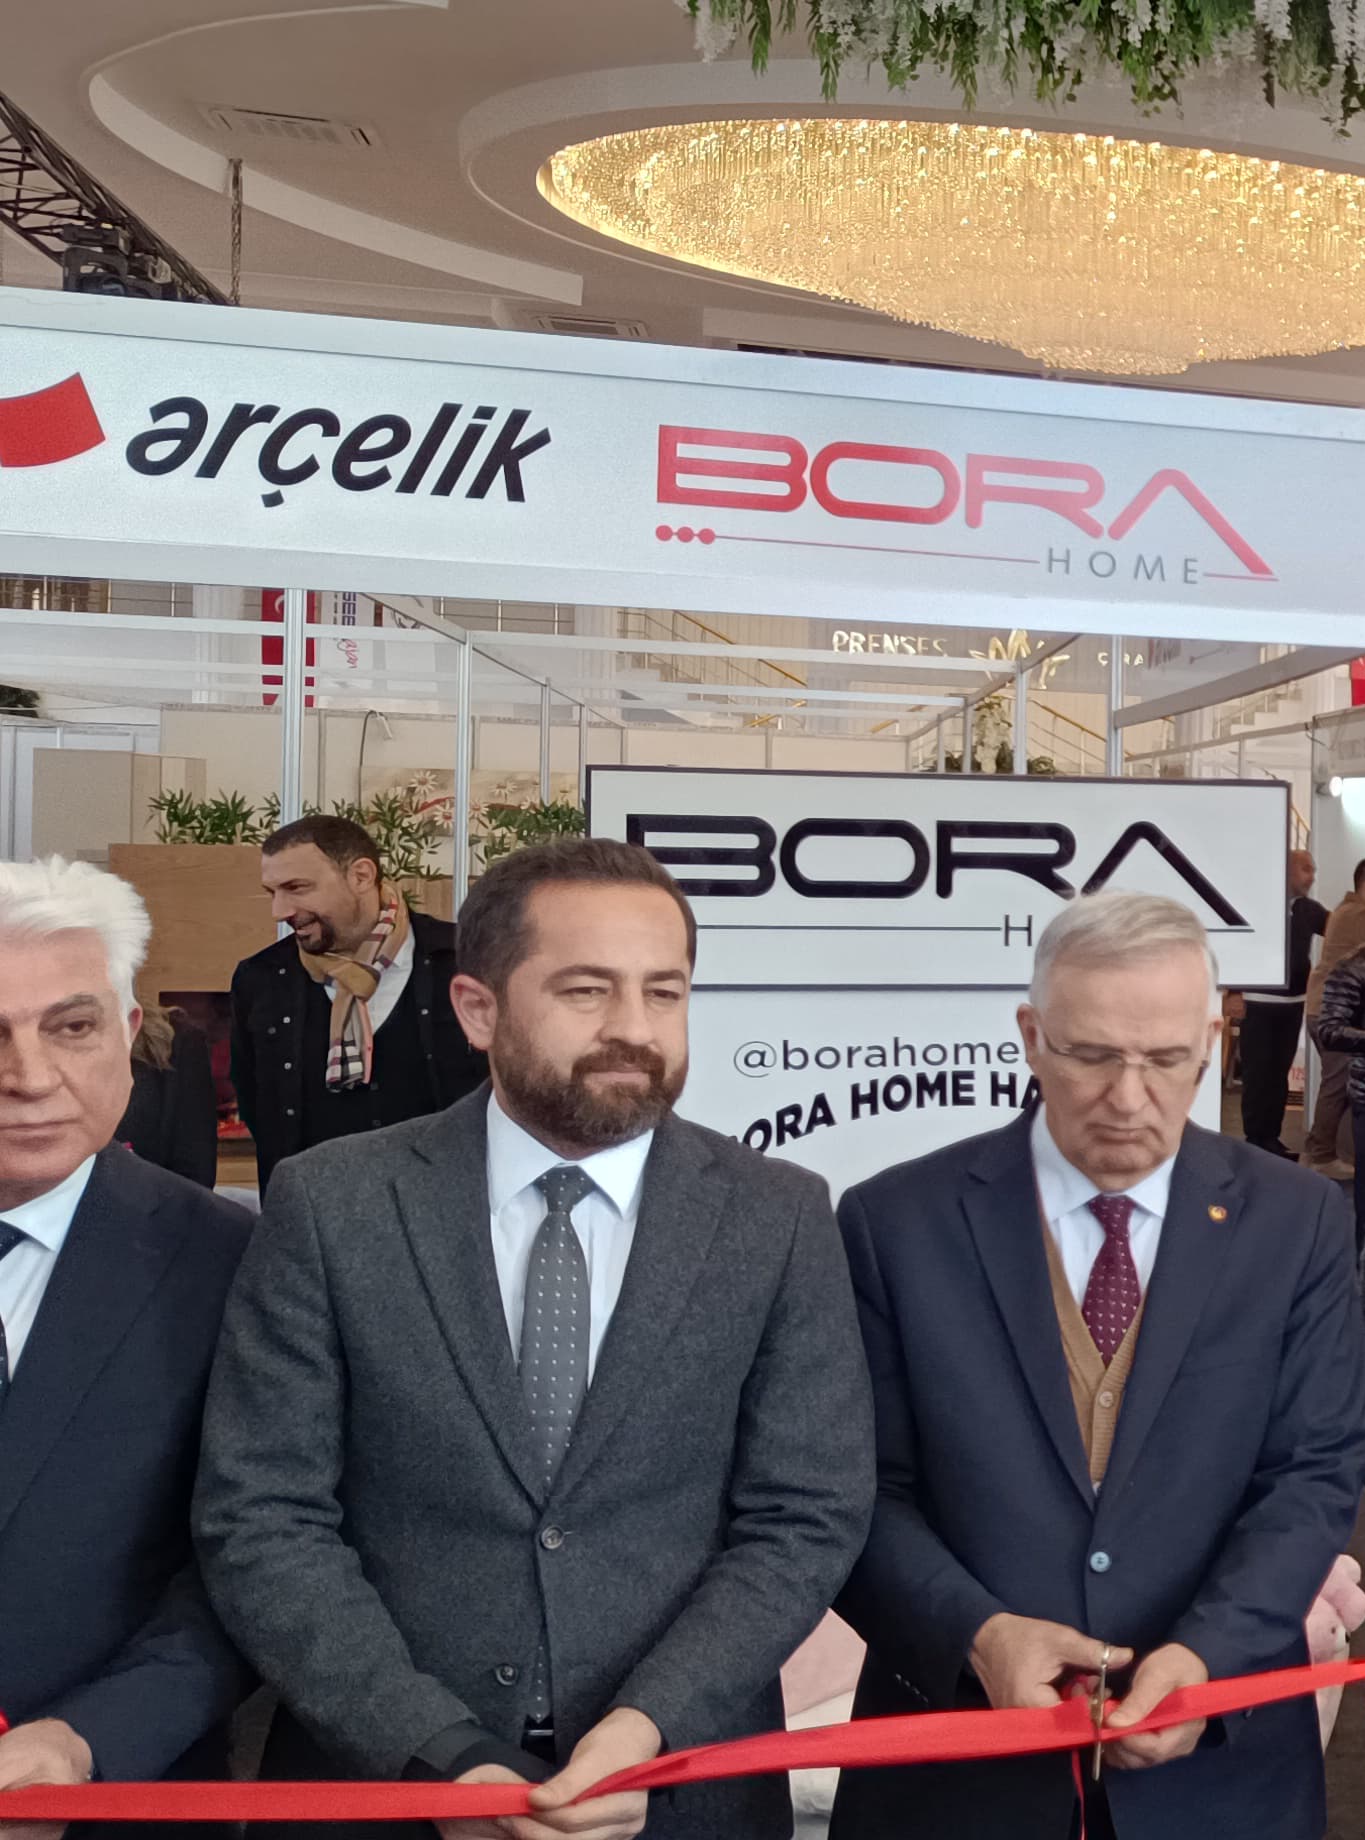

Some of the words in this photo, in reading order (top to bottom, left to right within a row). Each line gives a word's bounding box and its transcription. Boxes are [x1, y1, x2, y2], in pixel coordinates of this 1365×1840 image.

[125, 396, 552, 508] arçelik
[657, 424, 1274, 576] BORA
[1047, 547, 1200, 585] HOME
[626, 813, 1252, 928] BORA
[733, 1092, 837, 1155] ORA
[850, 1069, 977, 1121] HOME
